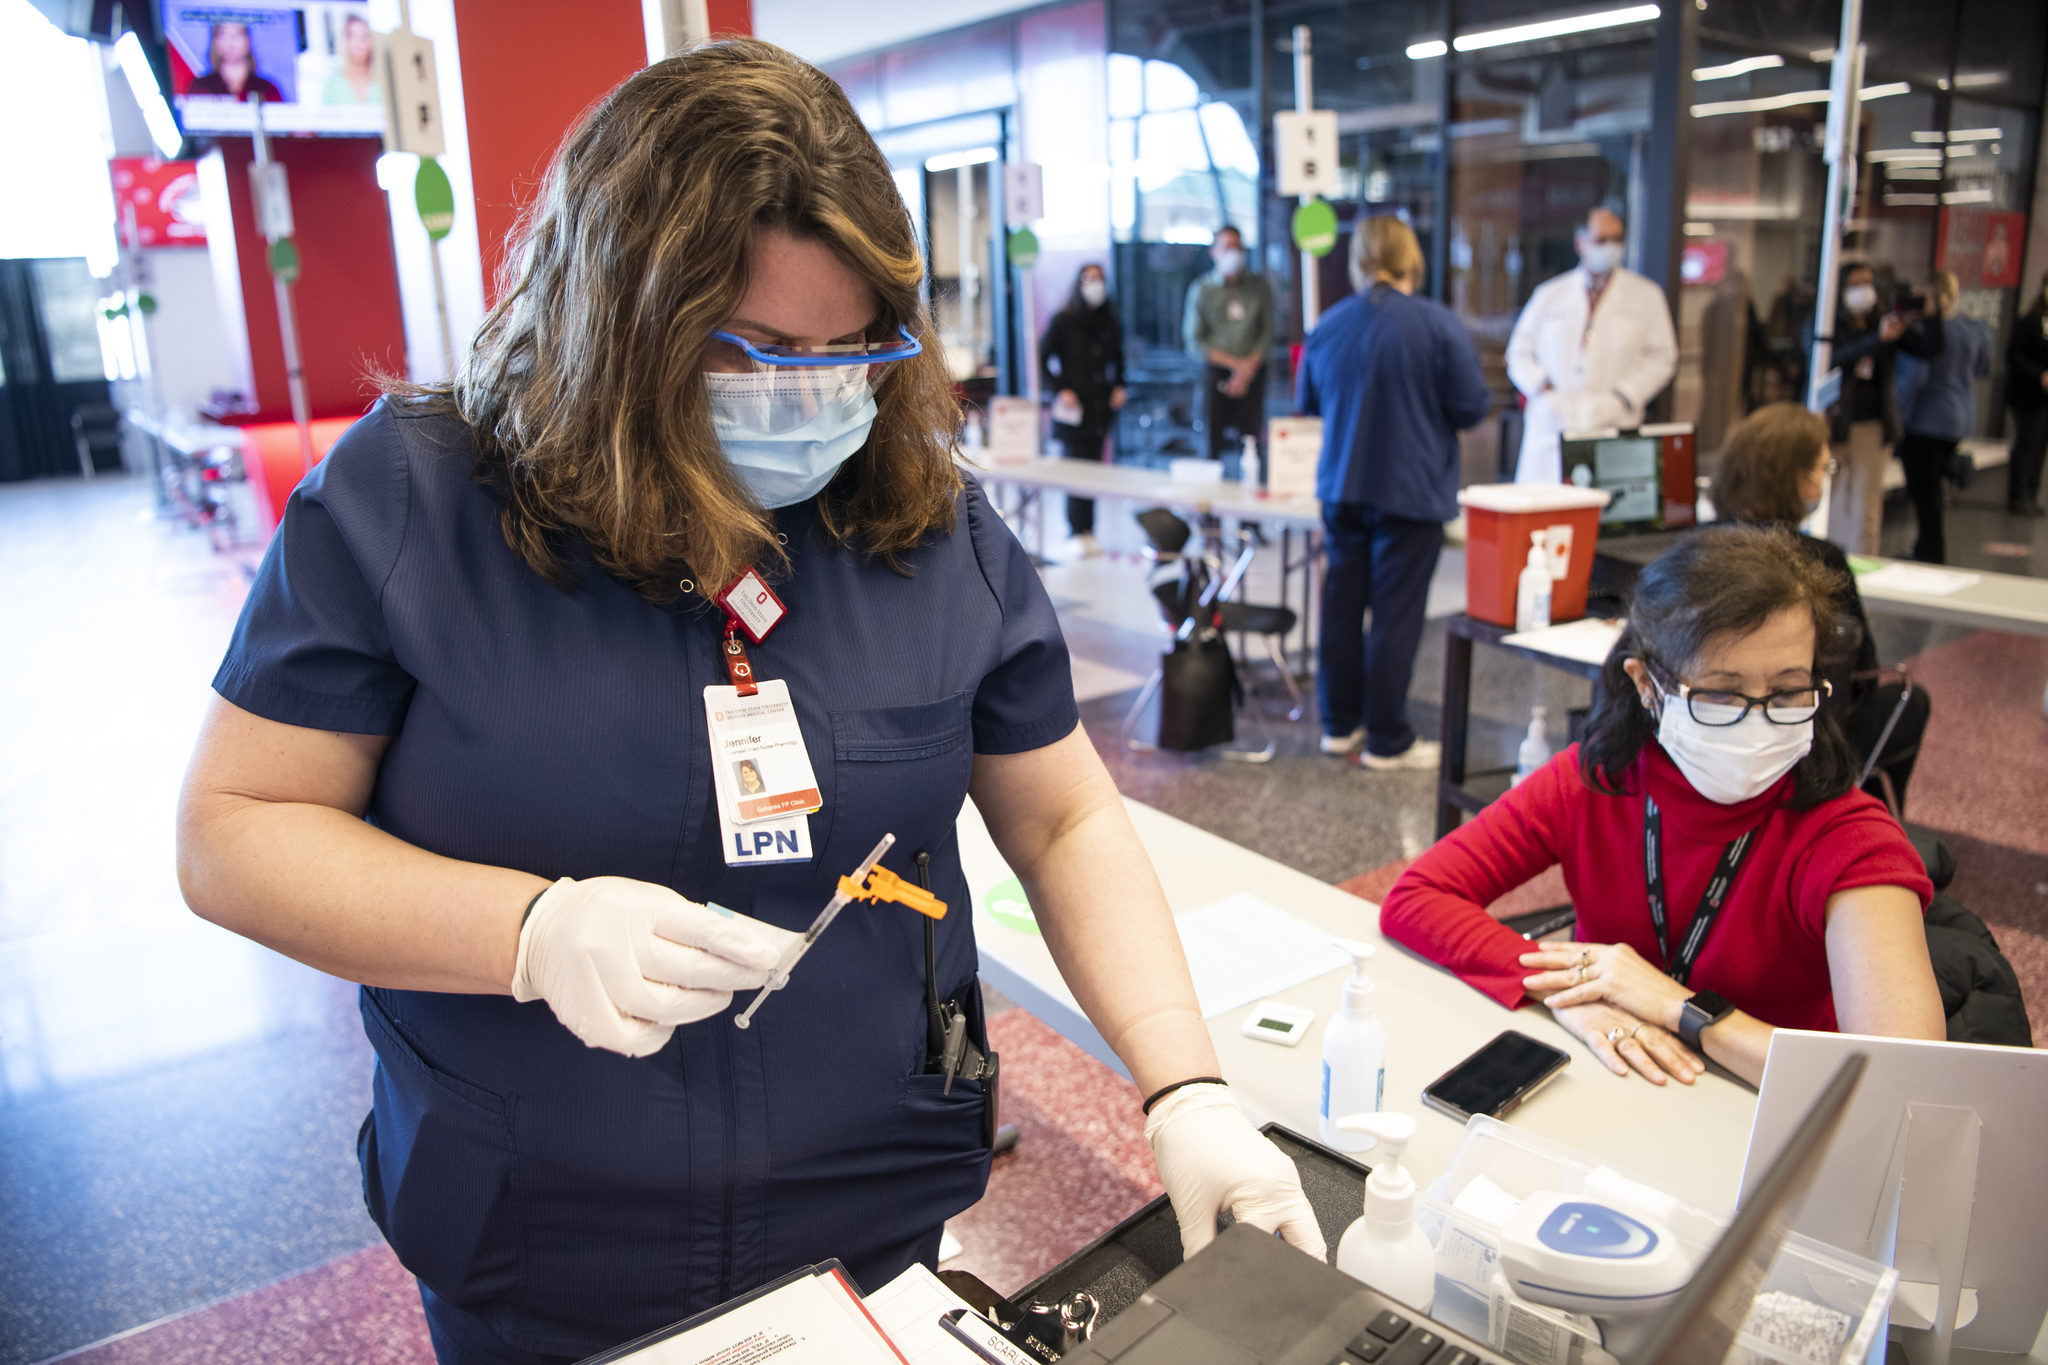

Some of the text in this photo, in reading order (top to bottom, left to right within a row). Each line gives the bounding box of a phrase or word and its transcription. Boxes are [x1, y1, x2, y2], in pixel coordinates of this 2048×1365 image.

[739, 598, 762, 623] UNIVERSITY
[756, 610, 768, 623] STATE
[761, 701, 789, 710] UNIVERSITY
[747, 710, 766, 718] MEDICAL
[723, 734, 762, 749] Jennifer
[757, 804, 781, 812] Gahanna
[735, 830, 799, 856] LPN
[732, 1340, 744, 1349] NOT
